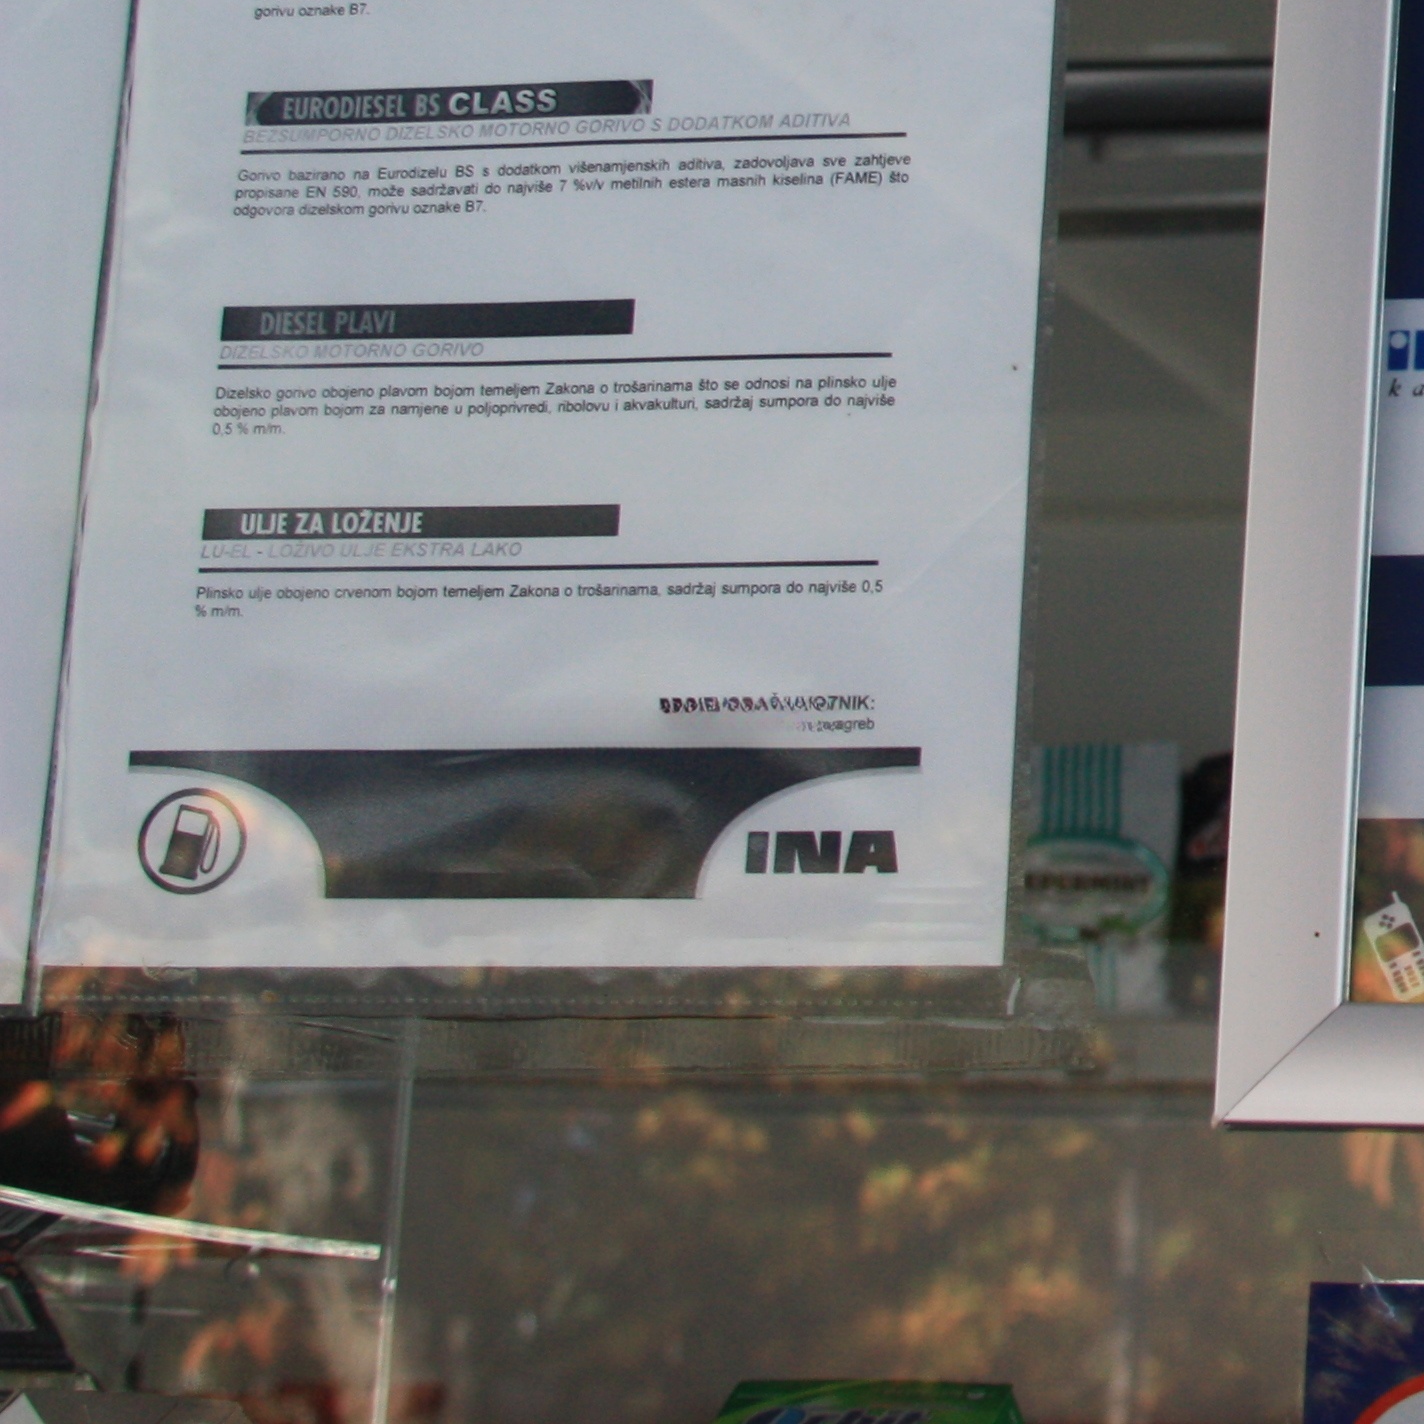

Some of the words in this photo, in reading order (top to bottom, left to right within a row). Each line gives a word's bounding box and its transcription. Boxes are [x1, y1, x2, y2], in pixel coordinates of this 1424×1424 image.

[254, 7, 294, 20] gorivu
[298, 4, 345, 16] oznake
[283, 94, 405, 120] EURODIESEL
[415, 94, 440, 116] BS
[448, 88, 556, 116] CLASS
[260, 312, 327, 336] DIESEL
[335, 311, 395, 333] PLAVI
[216, 386, 271, 400] Dizelsko
[276, 389, 316, 402] gorivo
[322, 386, 374, 401] obojeno
[379, 384, 428, 399] plavom
[434, 384, 474, 399] bojom
[480, 383, 540, 399] temeljem
[545, 381, 594, 395] Zakona
[600, 384, 608, 394] o
[614, 380, 693, 394] trošarinama
[698, 378, 718, 391] što
[724, 381, 739, 390] se
[745, 377, 789, 390] odnosi
[795, 378, 812, 389] na
[818, 376, 866, 391] plinsko
[872, 375, 896, 391] ulje
[240, 513, 288, 535] ULJE
[295, 513, 324, 534] ZA
[331, 510, 423, 534] LOŽENJE
[196, 587, 243, 599] Plinsko
[249, 587, 271, 602] ulje
[277, 588, 329, 601] obojeno
[335, 588, 391, 598] crvenom
[397, 586, 437, 600] bojom
[443, 584, 504, 601] temeljem
[509, 584, 559, 597] Zakona
[564, 587, 572, 597] o
[667, 582, 715, 598] sadržaj
[722, 584, 781, 596] sumpora
[786, 581, 803, 594] do
[809, 580, 856, 597] najviše
[862, 580, 883, 593] 0,5
[745, 831, 898, 873] INA
